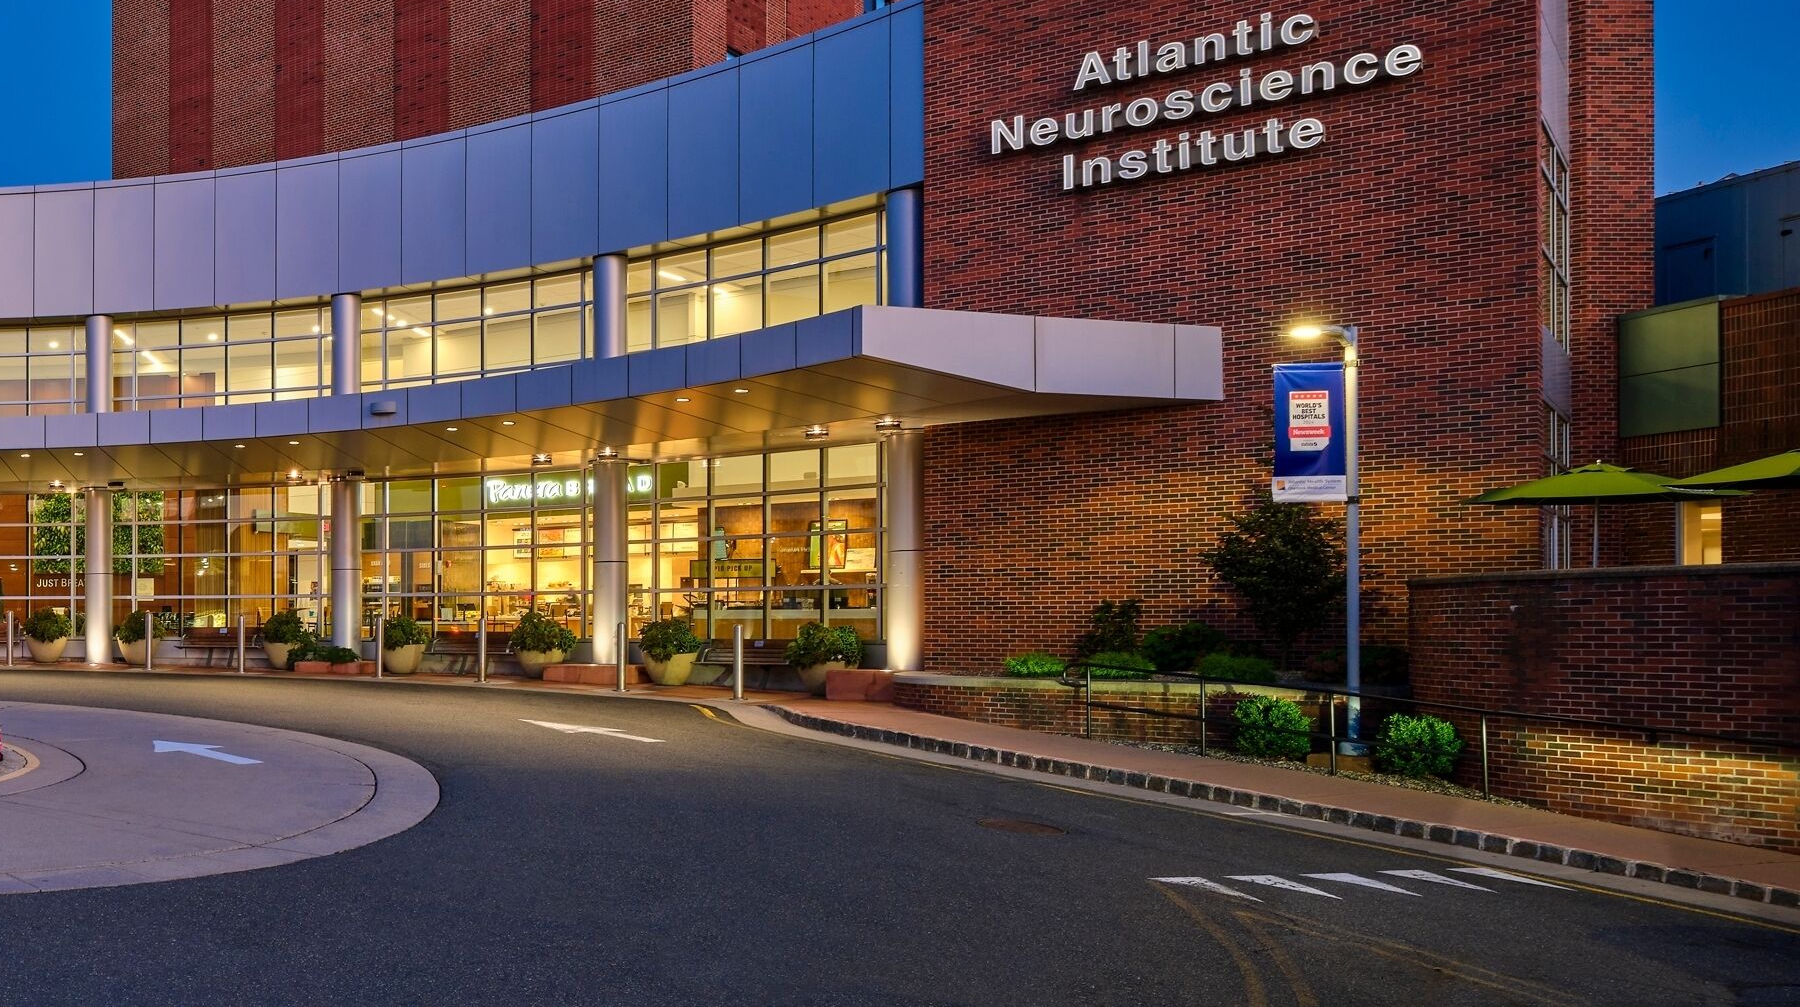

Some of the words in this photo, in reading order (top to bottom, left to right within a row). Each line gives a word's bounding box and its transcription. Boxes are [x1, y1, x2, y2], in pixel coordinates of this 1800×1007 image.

[1073, 11, 1318, 90] Atlantic
[990, 43, 1423, 154] Neuroscience
[1062, 117, 1325, 191] Institute
[36, 578, 60, 588] JUST
